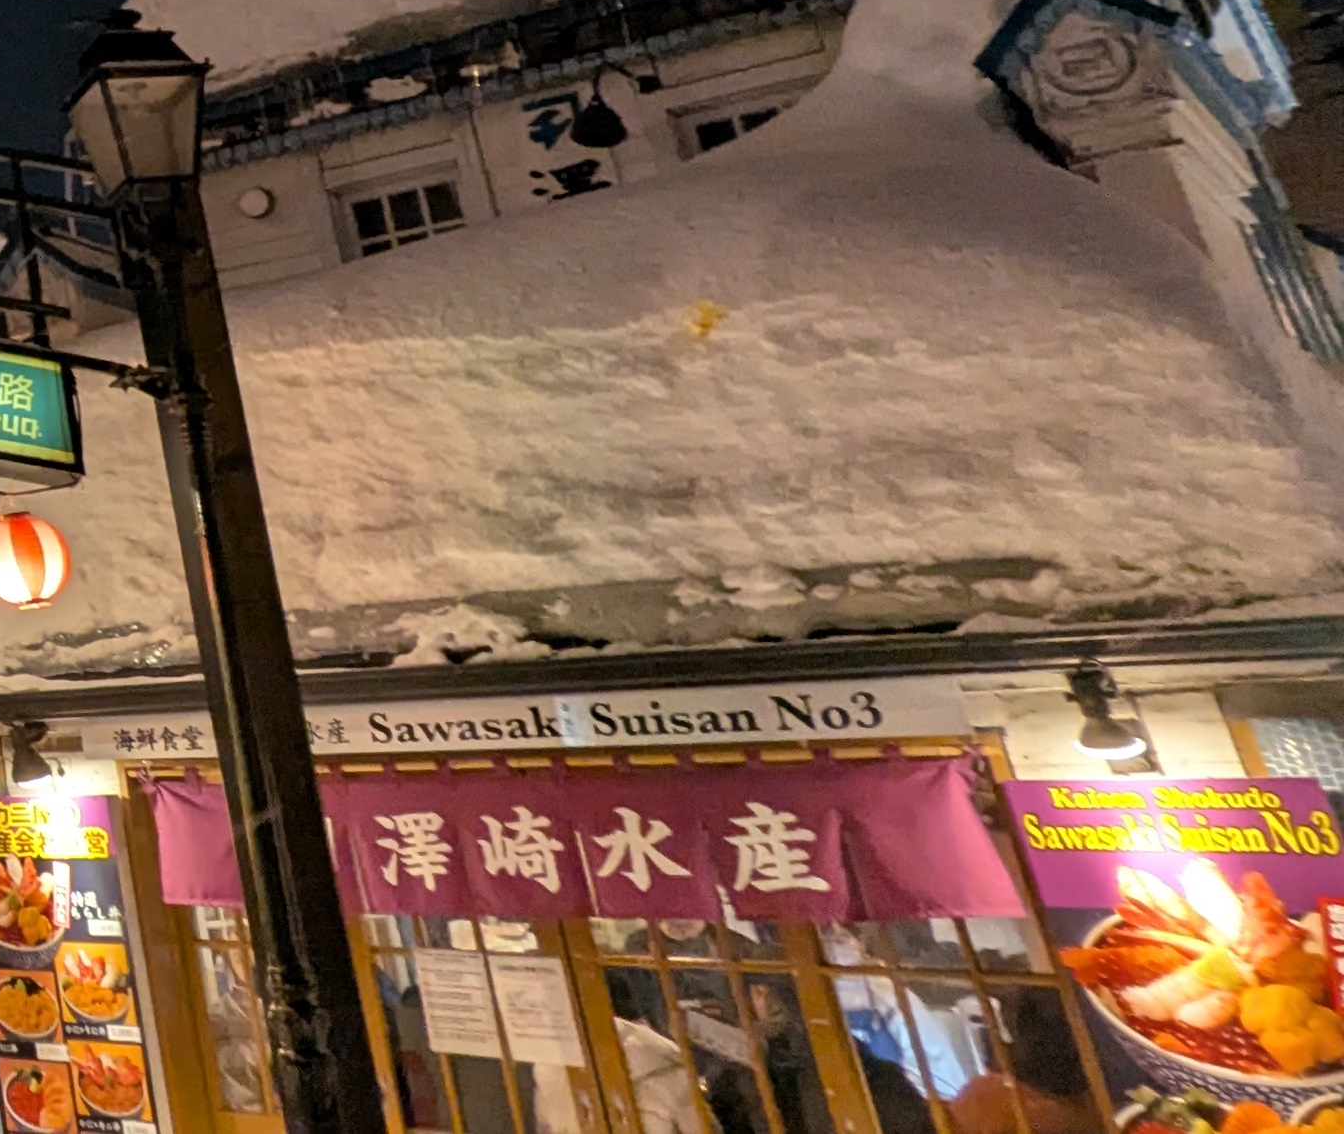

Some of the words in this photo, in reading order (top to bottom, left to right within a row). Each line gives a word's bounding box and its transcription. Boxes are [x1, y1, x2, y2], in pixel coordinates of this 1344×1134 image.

[112, 725, 205, 753] 海鮮食堂
[368, 705, 574, 746] Sawasaki
[588, 701, 759, 737] Suisan
[768, 691, 883, 733] No3
[1048, 786, 1146, 810] Kaisen
[1150, 785, 1282, 810] Shokudo
[372, 801, 832, 896] 澤崎水産
[1260, 810, 1342, 856] No3
